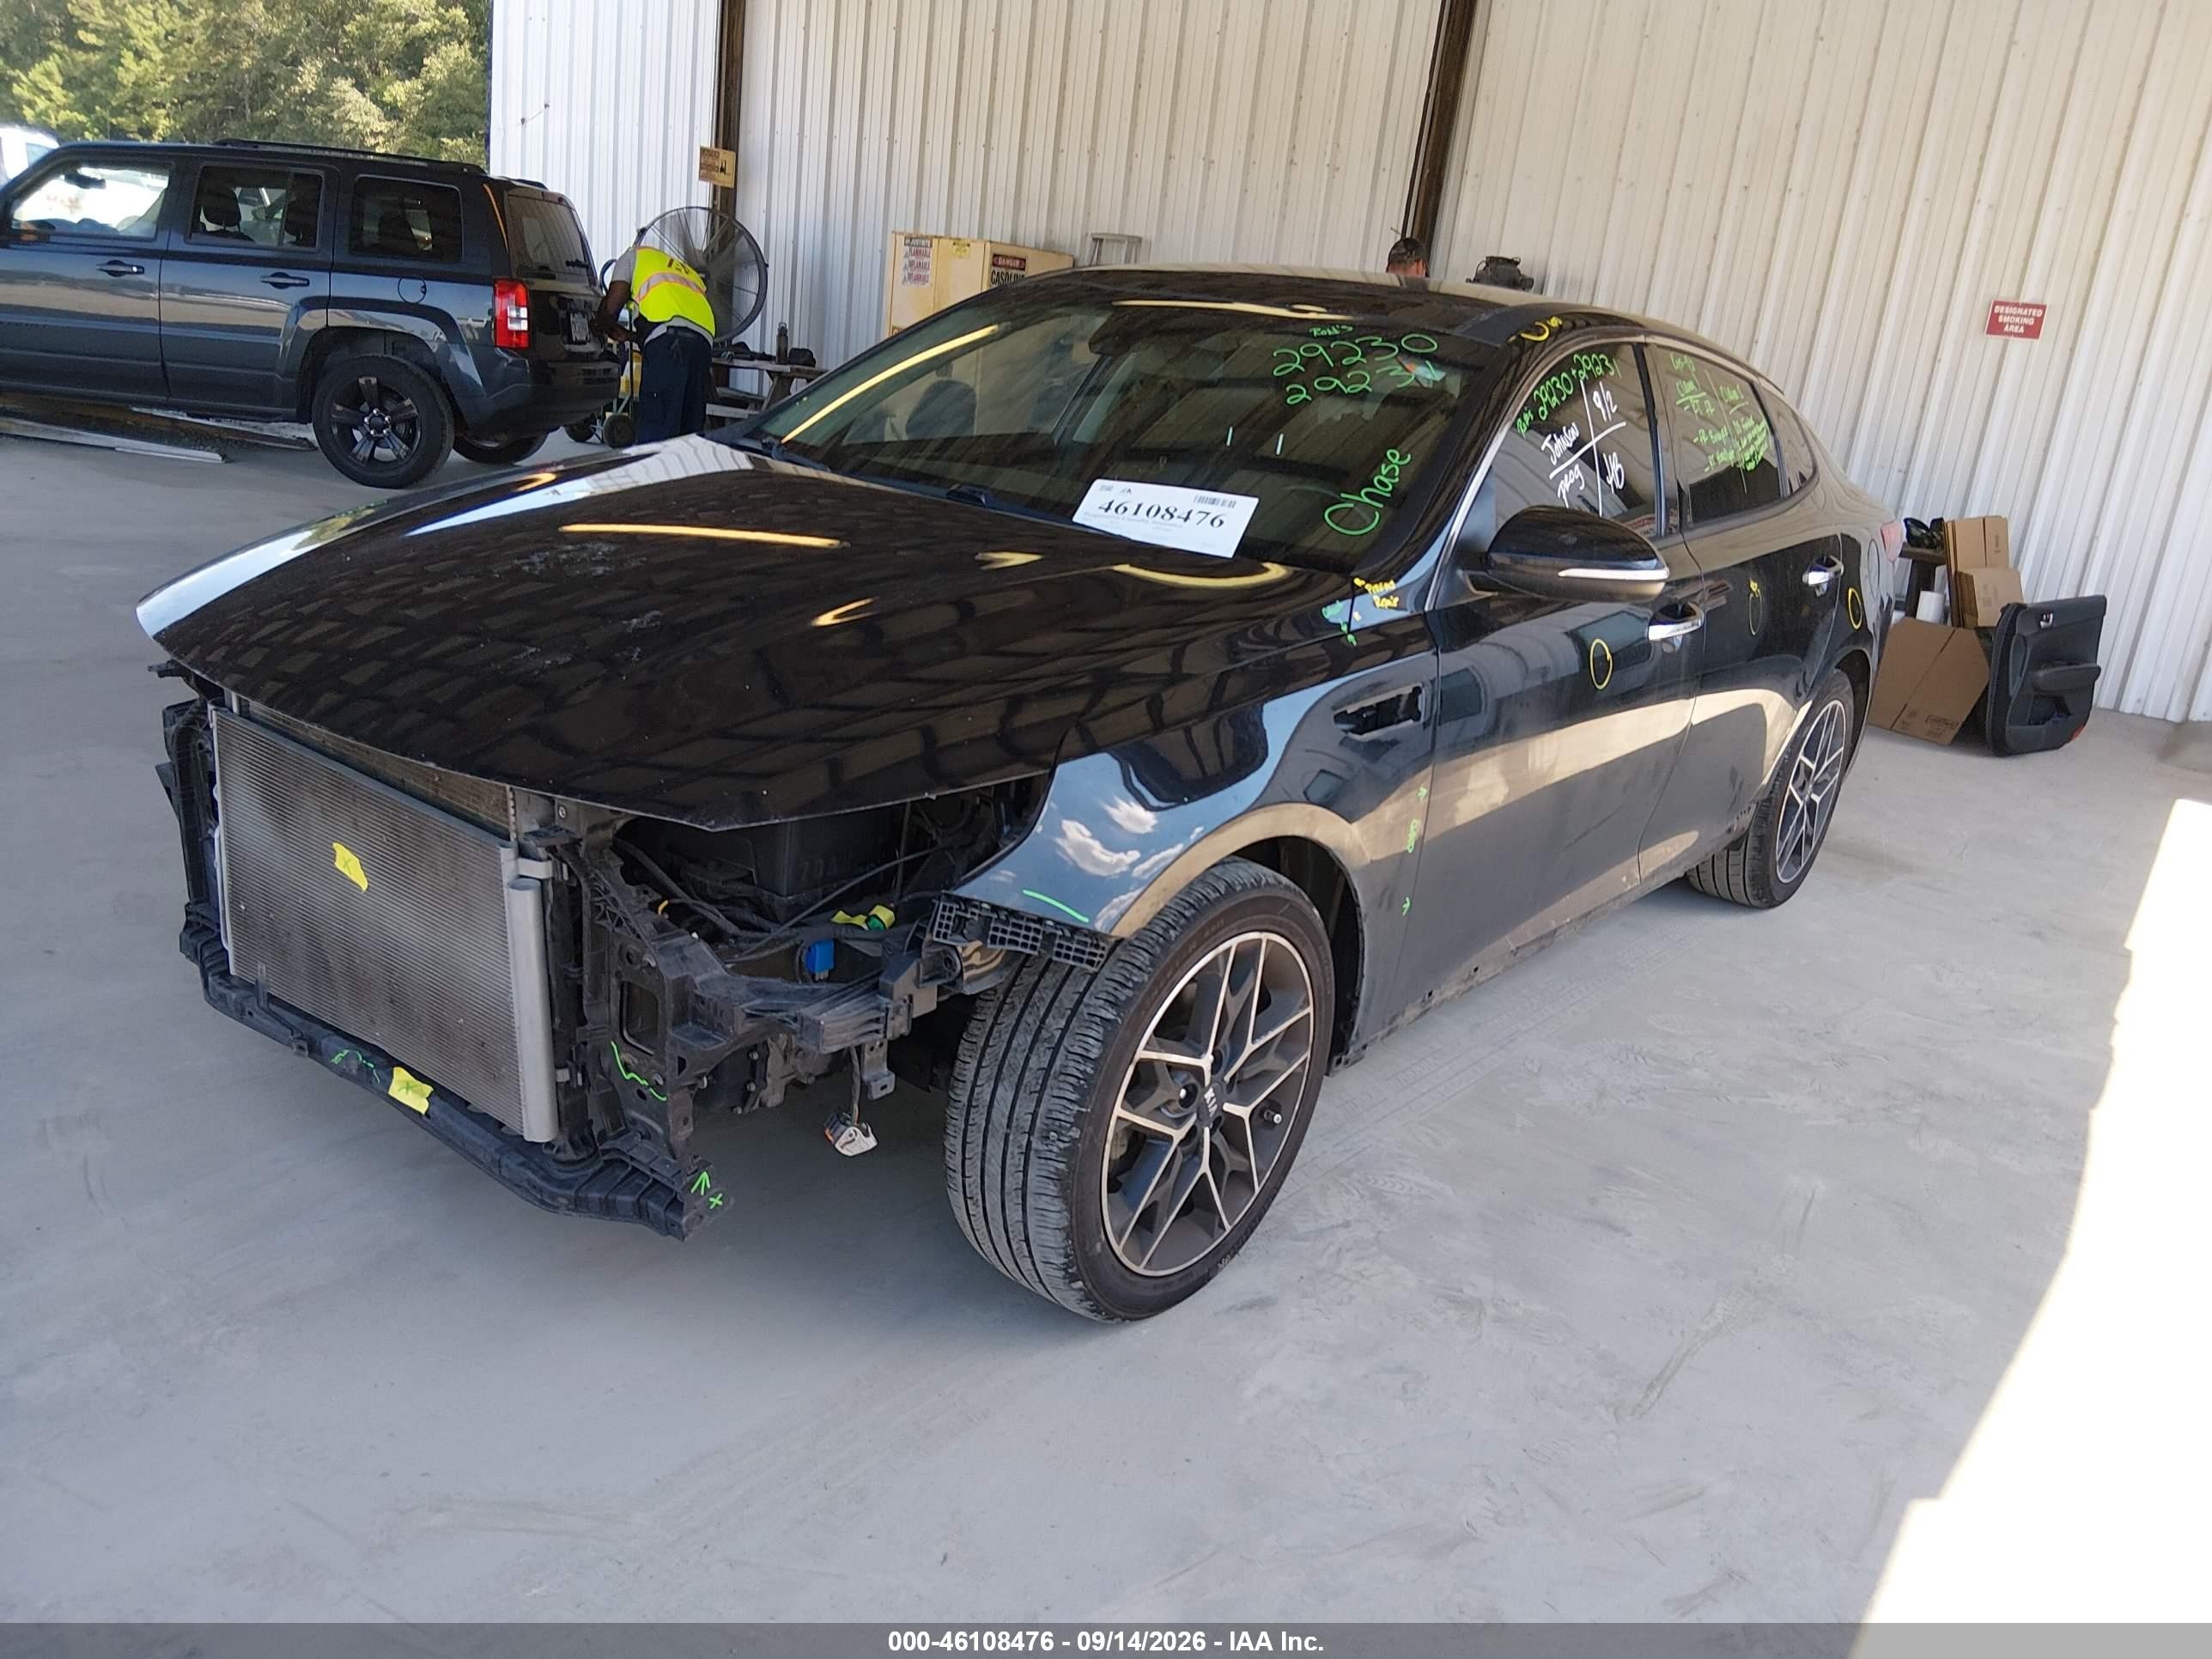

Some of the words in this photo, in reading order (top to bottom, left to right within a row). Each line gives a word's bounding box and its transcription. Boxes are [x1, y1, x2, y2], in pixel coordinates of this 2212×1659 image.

[1994, 305, 2043, 317] DESIGNATED
[1998, 314, 2035, 325] SMOKING
[2003, 324, 2025, 333] AREA
[1273, 332, 1438, 376] 29230
[1286, 360, 1443, 405] 29231
[1533, 372, 1574, 422] 29230
[1573, 353, 1622, 380] 29231
[1324, 448, 1412, 536] Chase
[1097, 499, 1226, 529] 46108476
